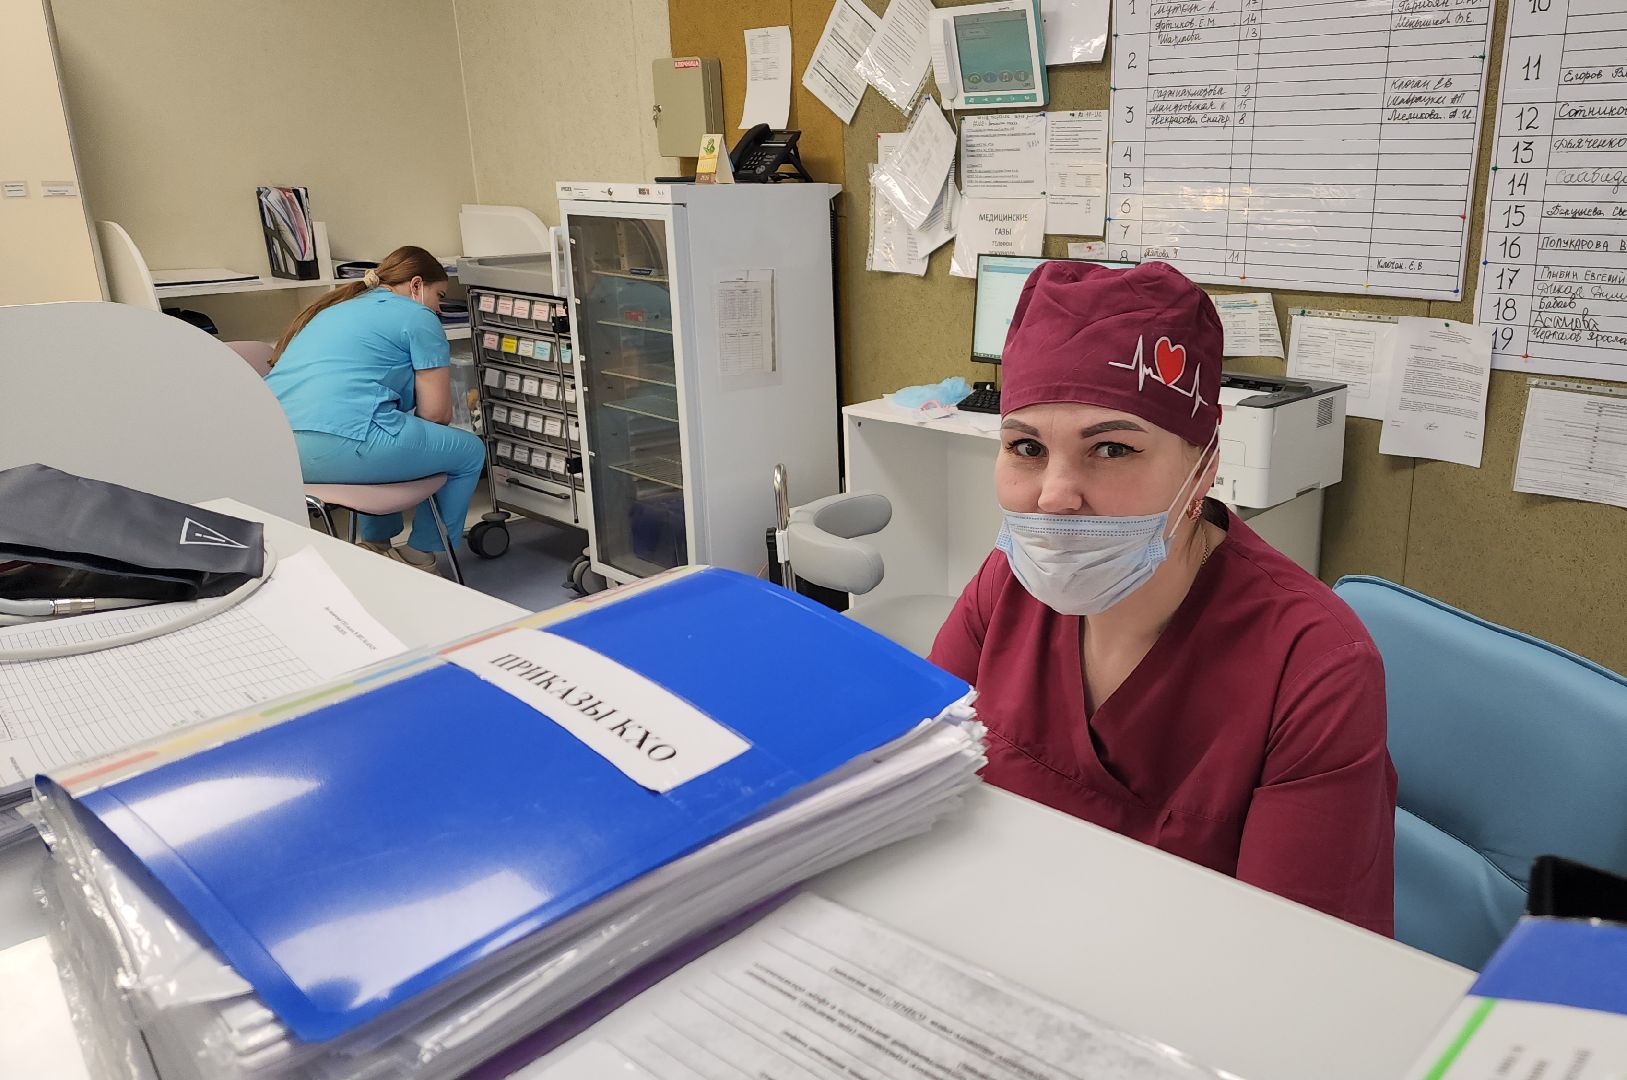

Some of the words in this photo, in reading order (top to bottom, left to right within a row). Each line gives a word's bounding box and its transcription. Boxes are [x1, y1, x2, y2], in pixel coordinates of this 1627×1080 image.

[1129, 0, 1136, 15] 1
[1243, 13, 1257, 24] 14
[1127, 52, 1137, 69] 2
[1522, 54, 1542, 80] 11
[1125, 106, 1135, 123] 3
[1239, 113, 1246, 124] 8
[1515, 107, 1539, 130] 12
[1123, 146, 1132, 162] 4
[1512, 141, 1534, 163] 13
[1123, 173, 1132, 188] 5
[1508, 173, 1528, 195] 14
[1121, 198, 1131, 213] 6
[979, 213, 1029, 222] МЕДИЦИНСКИЕ
[1503, 205, 1525, 228] 15
[1120, 224, 1130, 239] 7
[1499, 236, 1521, 258] 16
[1496, 268, 1520, 289] 17
[1493, 297, 1516, 321] 18
[1492, 327, 1514, 350] 19
[489, 653, 614, 723] ПРИКАЗЫ
[608, 719, 677, 762] КХО
